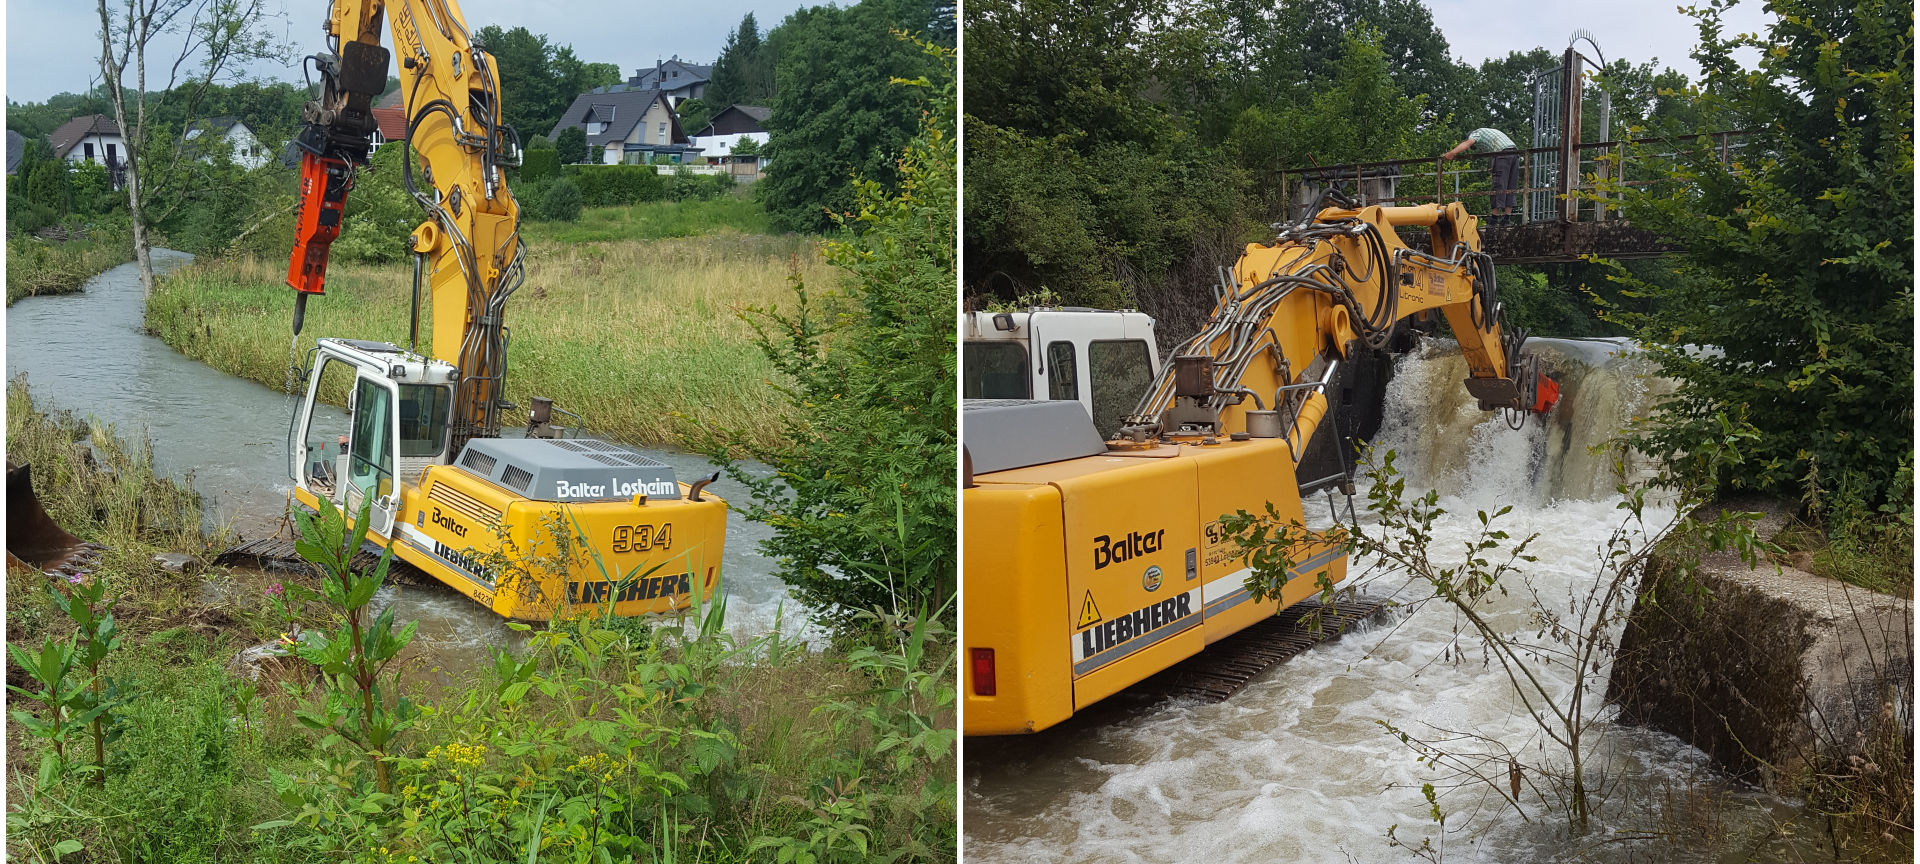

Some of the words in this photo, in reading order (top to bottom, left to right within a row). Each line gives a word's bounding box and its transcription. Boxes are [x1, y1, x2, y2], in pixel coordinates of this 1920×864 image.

[394, 18, 412, 73] Litron
[294, 177, 310, 248] RAMMER
[1400, 288, 1424, 304] Litronic
[556, 480, 606, 498] Balter
[612, 477, 675, 497] Losheim
[431, 507, 468, 538] Balter
[612, 522, 672, 553] 934
[1094, 529, 1165, 571] Balter
[1082, 591, 1192, 659] LIEBHERR
